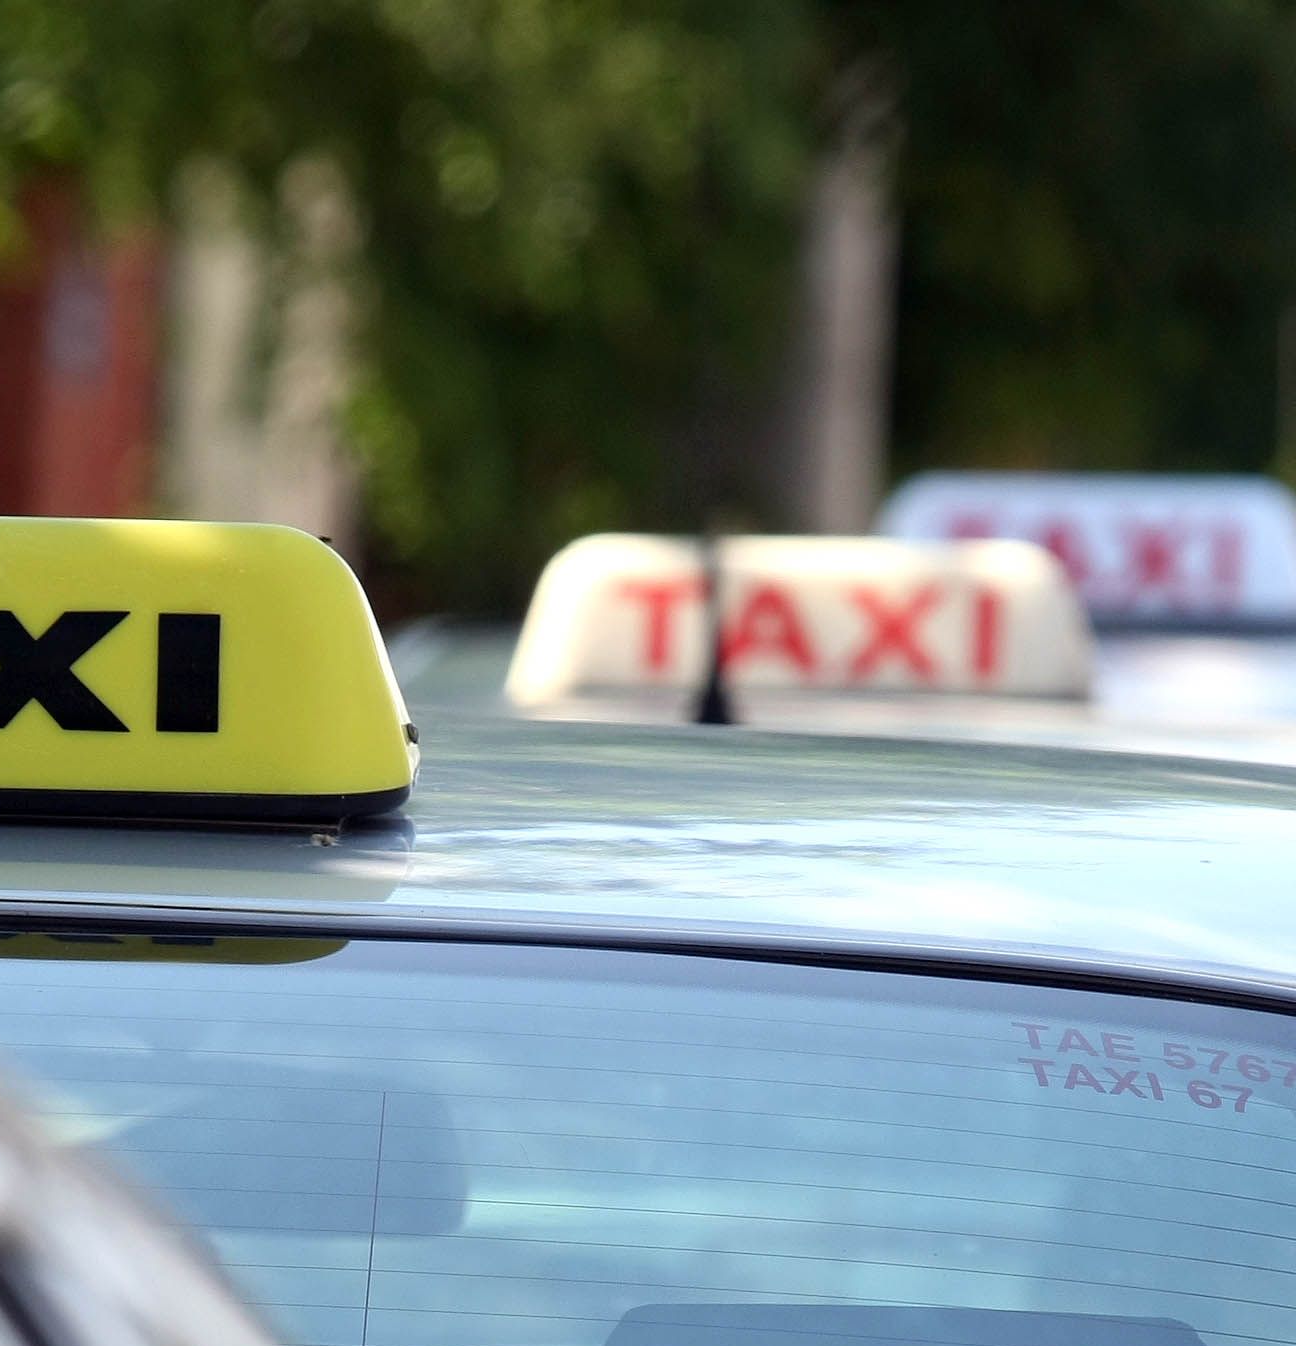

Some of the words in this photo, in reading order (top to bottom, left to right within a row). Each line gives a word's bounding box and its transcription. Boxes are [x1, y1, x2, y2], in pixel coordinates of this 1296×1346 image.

[617, 578, 1010, 686] TAXI
[1010, 1021, 1142, 1064] TAE
[1017, 1057, 1166, 1102] TAXI
[1186, 1079, 1255, 1114] 67
